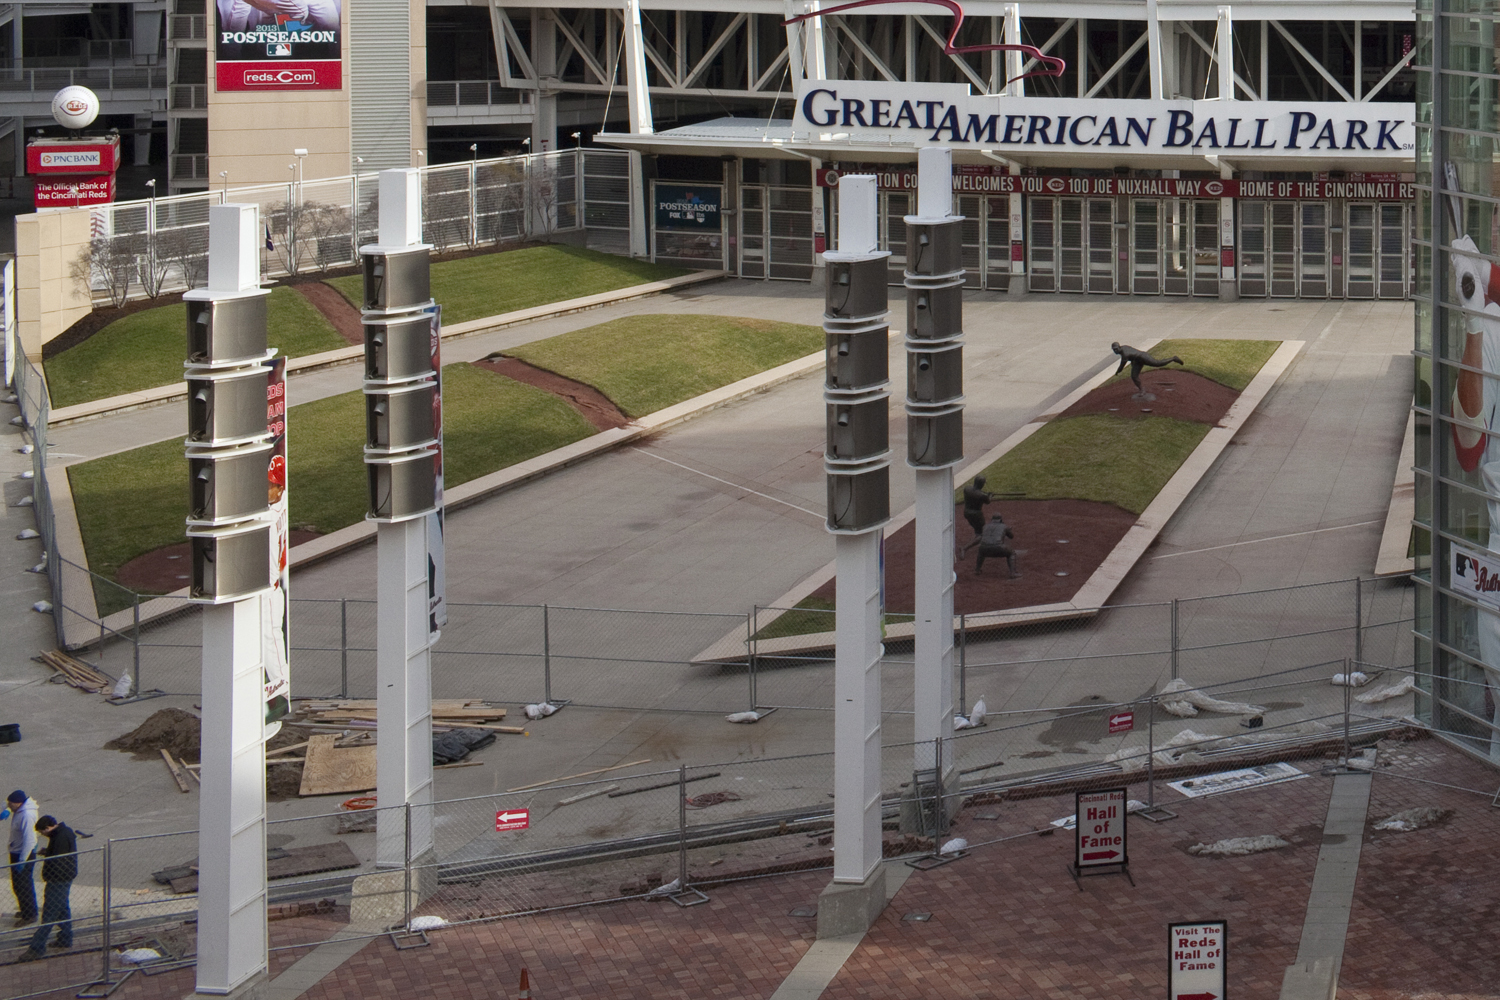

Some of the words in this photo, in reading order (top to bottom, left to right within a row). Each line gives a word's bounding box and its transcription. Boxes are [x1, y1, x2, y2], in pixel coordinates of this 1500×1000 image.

[222, 31, 335, 43] POSTSEASON
[67, 101, 88, 109] REDS
[1162, 109, 1277, 150] BALL
[1283, 111, 1405, 151] PARK
[53, 155, 73, 163] PNC
[73, 154, 98, 162] BANK
[37, 183, 52, 191] The
[53, 182, 78, 191] Official
[79, 181, 97, 190] Bank
[98, 181, 107, 189] of
[952, 176, 1014, 192] WELCOMES
[1020, 177, 1043, 193] YOU
[1068, 178, 1090, 194] 100
[1093, 179, 1113, 194] JOE
[1117, 179, 1172, 195] NUXHALL
[1175, 180, 1202, 195] WAY
[1239, 181, 1274, 197] HOME
[1278, 182, 1293, 197] OF
[1297, 182, 1320, 197] THE
[1324, 182, 1395, 198] CINCINNATI
[37, 192, 50, 200] the
[88, 190, 107, 198] Reds
[660, 202, 717, 212] POSTSEASON
[1080, 793, 1108, 803] Cincinnati
[1109, 792, 1125, 801] Reds
[1087, 805, 1117, 820] Hall
[1093, 821, 1110, 834] of
[1081, 835, 1122, 848] Fame
[1174, 928, 1199, 936] Visit
[1202, 927, 1221, 935] The
[1178, 936, 1217, 948] Reds
[1174, 949, 1201, 960] Hall
[1206, 948, 1221, 958] of
[1179, 961, 1216, 971] Fame
